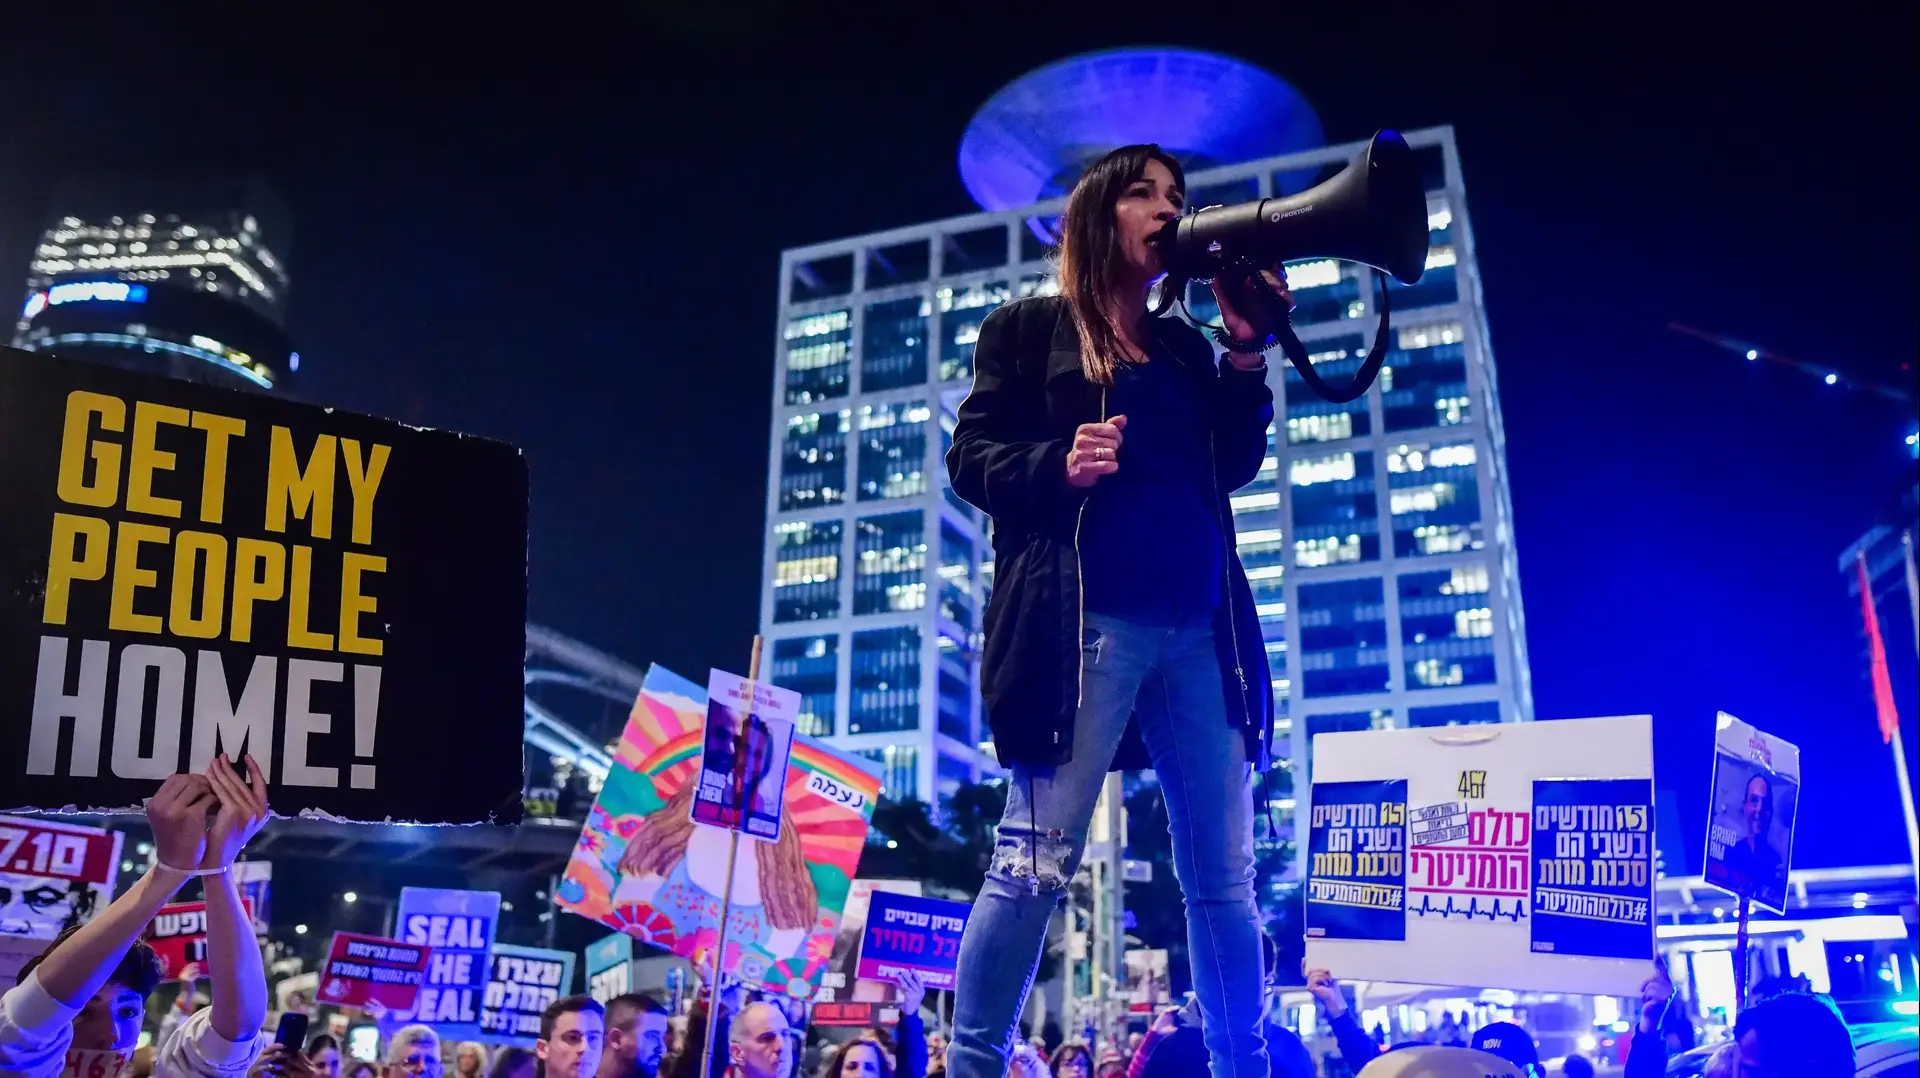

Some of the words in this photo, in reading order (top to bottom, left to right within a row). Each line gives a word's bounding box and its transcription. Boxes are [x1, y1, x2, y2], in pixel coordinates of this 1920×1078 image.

[57, 390, 246, 524] GET
[264, 425, 391, 545] MY
[43, 512, 387, 655] PEOPLE
[26, 635, 382, 789] HOME!
[812, 777, 863, 807] נעמה
[1458, 770, 1487, 798] 467
[1312, 804, 1376, 828] חודשים
[1468, 808, 1530, 846] כולם
[1535, 805, 1614, 831] חודשים
[1617, 805, 1645, 831] 15
[1328, 828, 1353, 851] הם
[1357, 828, 1403, 851] בשבי
[1556, 832, 1586, 858] הם
[1591, 832, 1648, 859] בשבי
[1711, 824, 1738, 847] BRING
[0, 826, 88, 876] 7.10
[1312, 852, 1353, 877] מוות
[1356, 852, 1403, 877] סכנת
[1410, 852, 1528, 890] הומניטרי
[1538, 859, 1586, 885] מוות
[1591, 860, 1647, 887] סכנת
[155, 911, 207, 937] ופש
[405, 914, 485, 948] SEAL
[932, 931, 959, 958] כל
[429, 953, 473, 985] HE
[394, 987, 476, 1022] EAL
